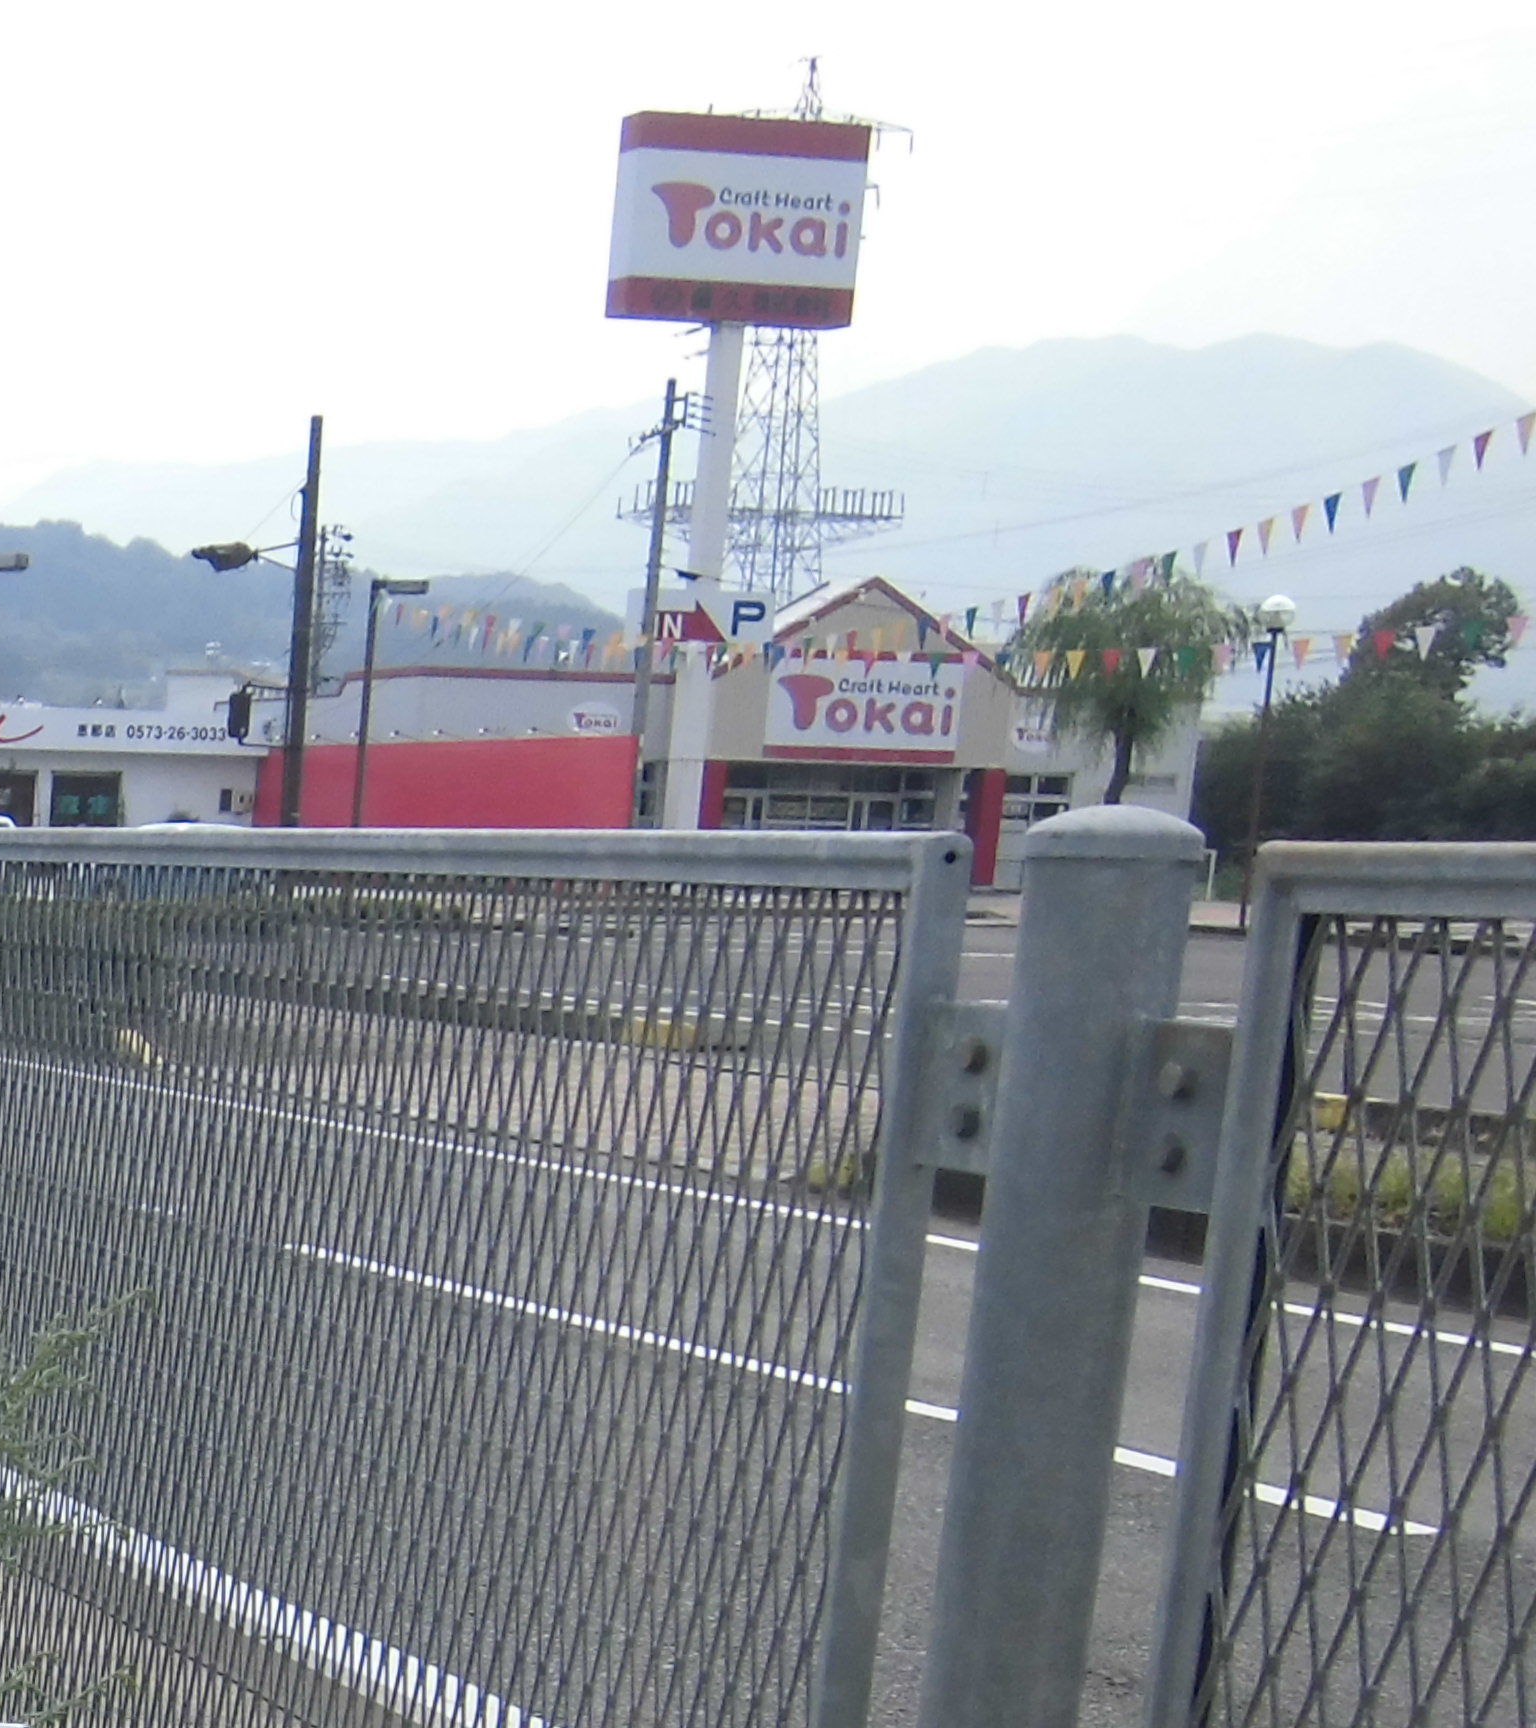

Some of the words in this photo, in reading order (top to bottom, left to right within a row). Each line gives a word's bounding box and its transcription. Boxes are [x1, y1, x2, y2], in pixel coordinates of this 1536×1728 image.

[719, 187, 771, 206] Craft
[775, 192, 833, 211] Heart
[651, 181, 850, 259] Tokai
[654, 613, 683, 640] IN
[732, 601, 766, 636] P
[778, 674, 955, 737] Tokai
[839, 678, 883, 693] Craft
[887, 680, 940, 696] Heart
